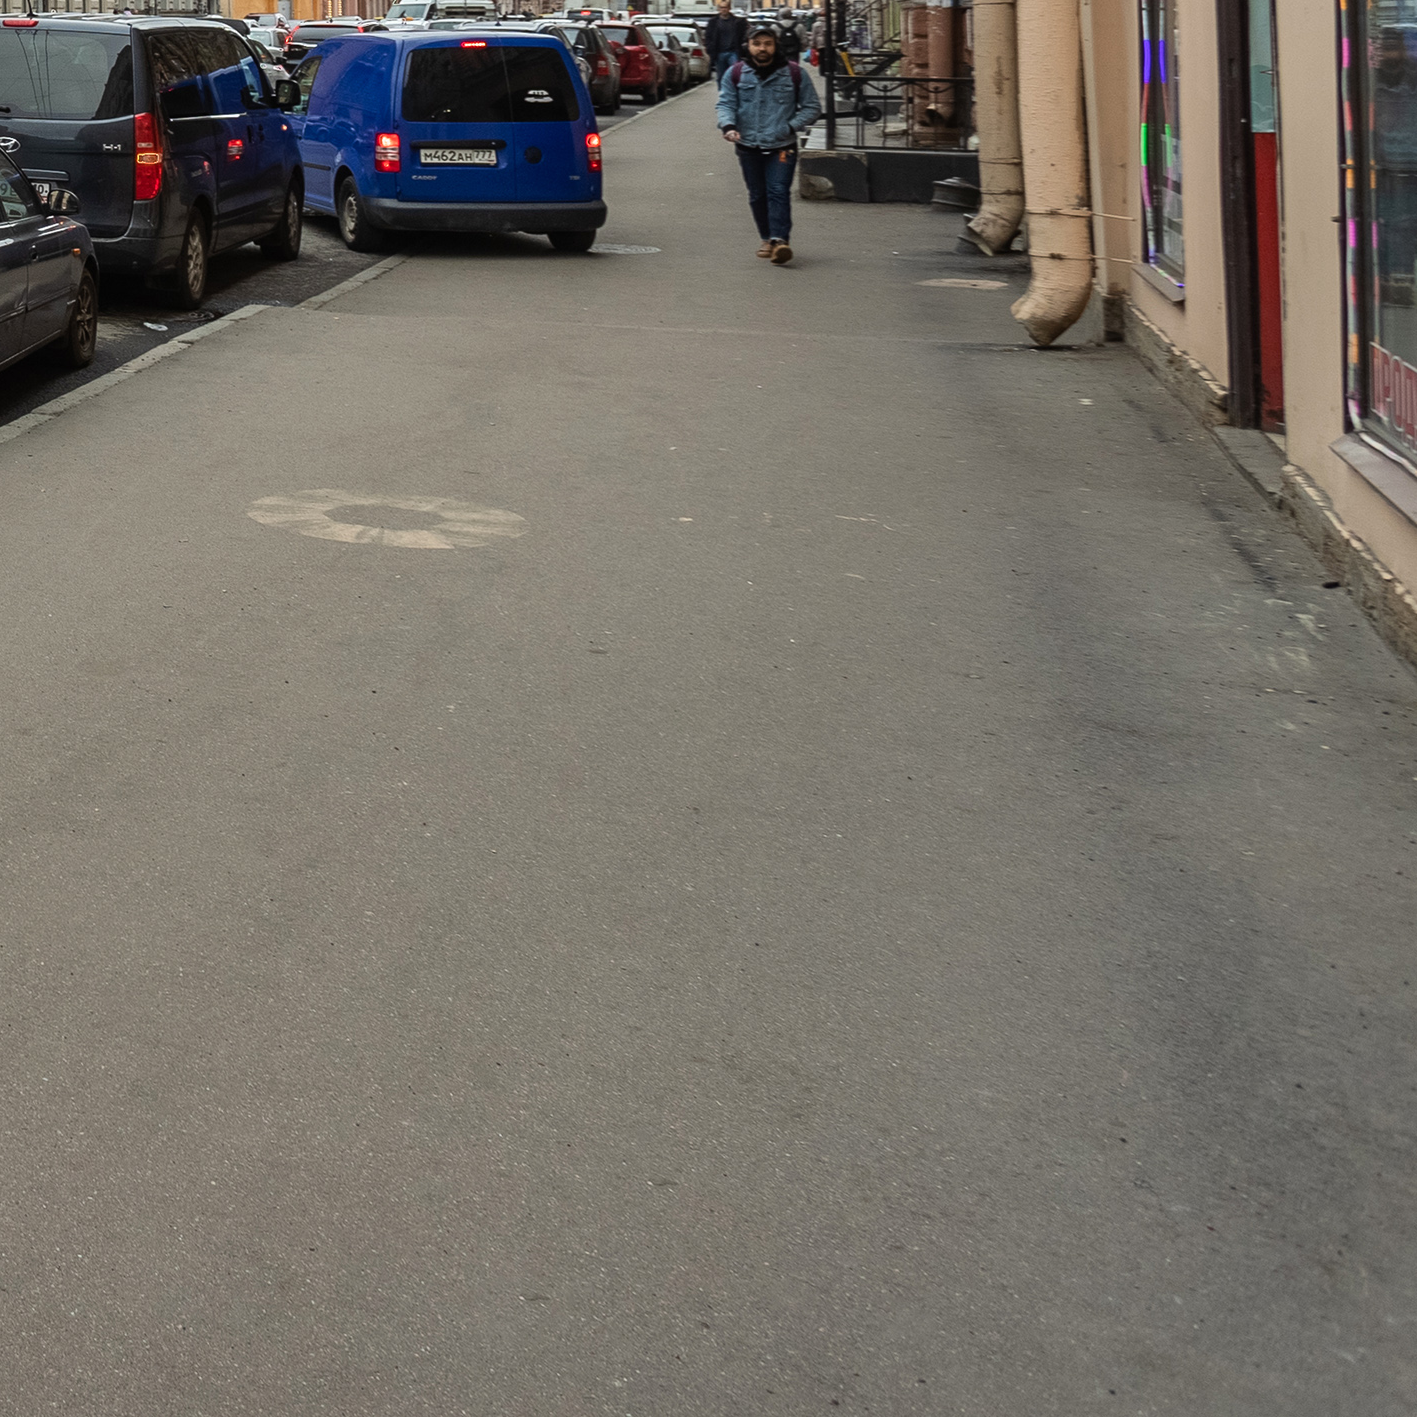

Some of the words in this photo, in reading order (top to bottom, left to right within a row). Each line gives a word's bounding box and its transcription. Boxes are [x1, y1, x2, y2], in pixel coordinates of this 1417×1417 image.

[102, 143, 122, 151] H-1
[423, 149, 473, 162] М462АН
[474, 150, 493, 159] 777
